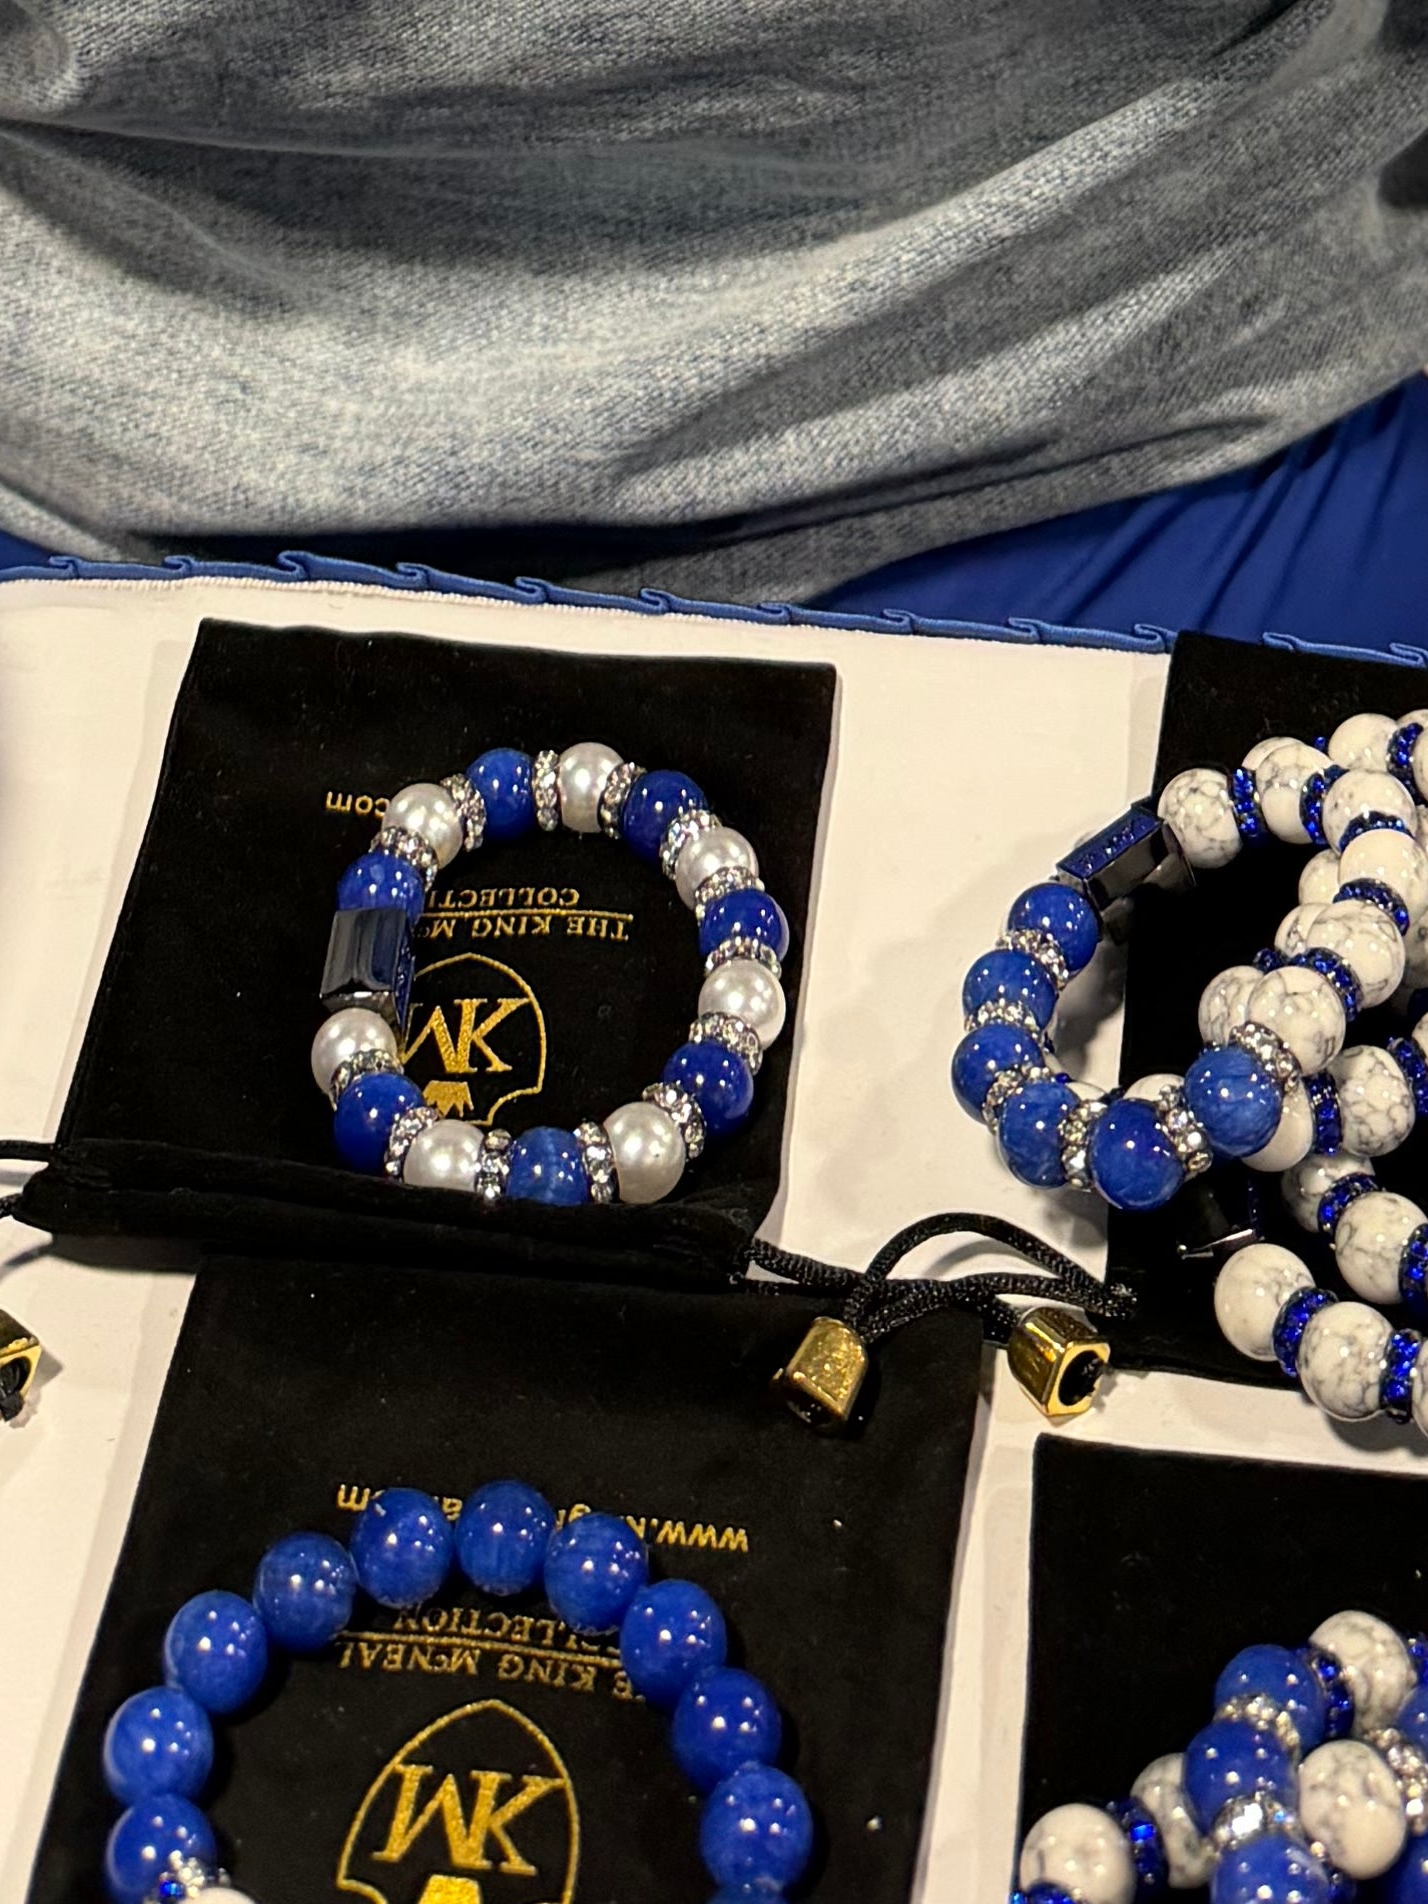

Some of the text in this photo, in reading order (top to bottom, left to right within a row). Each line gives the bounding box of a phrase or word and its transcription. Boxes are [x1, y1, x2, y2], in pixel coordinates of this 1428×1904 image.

[428, 886, 580, 909] COLLECTI
[471, 915, 551, 938] KING
[566, 916, 630, 942] THE
[498, 1651, 595, 1691] KING
